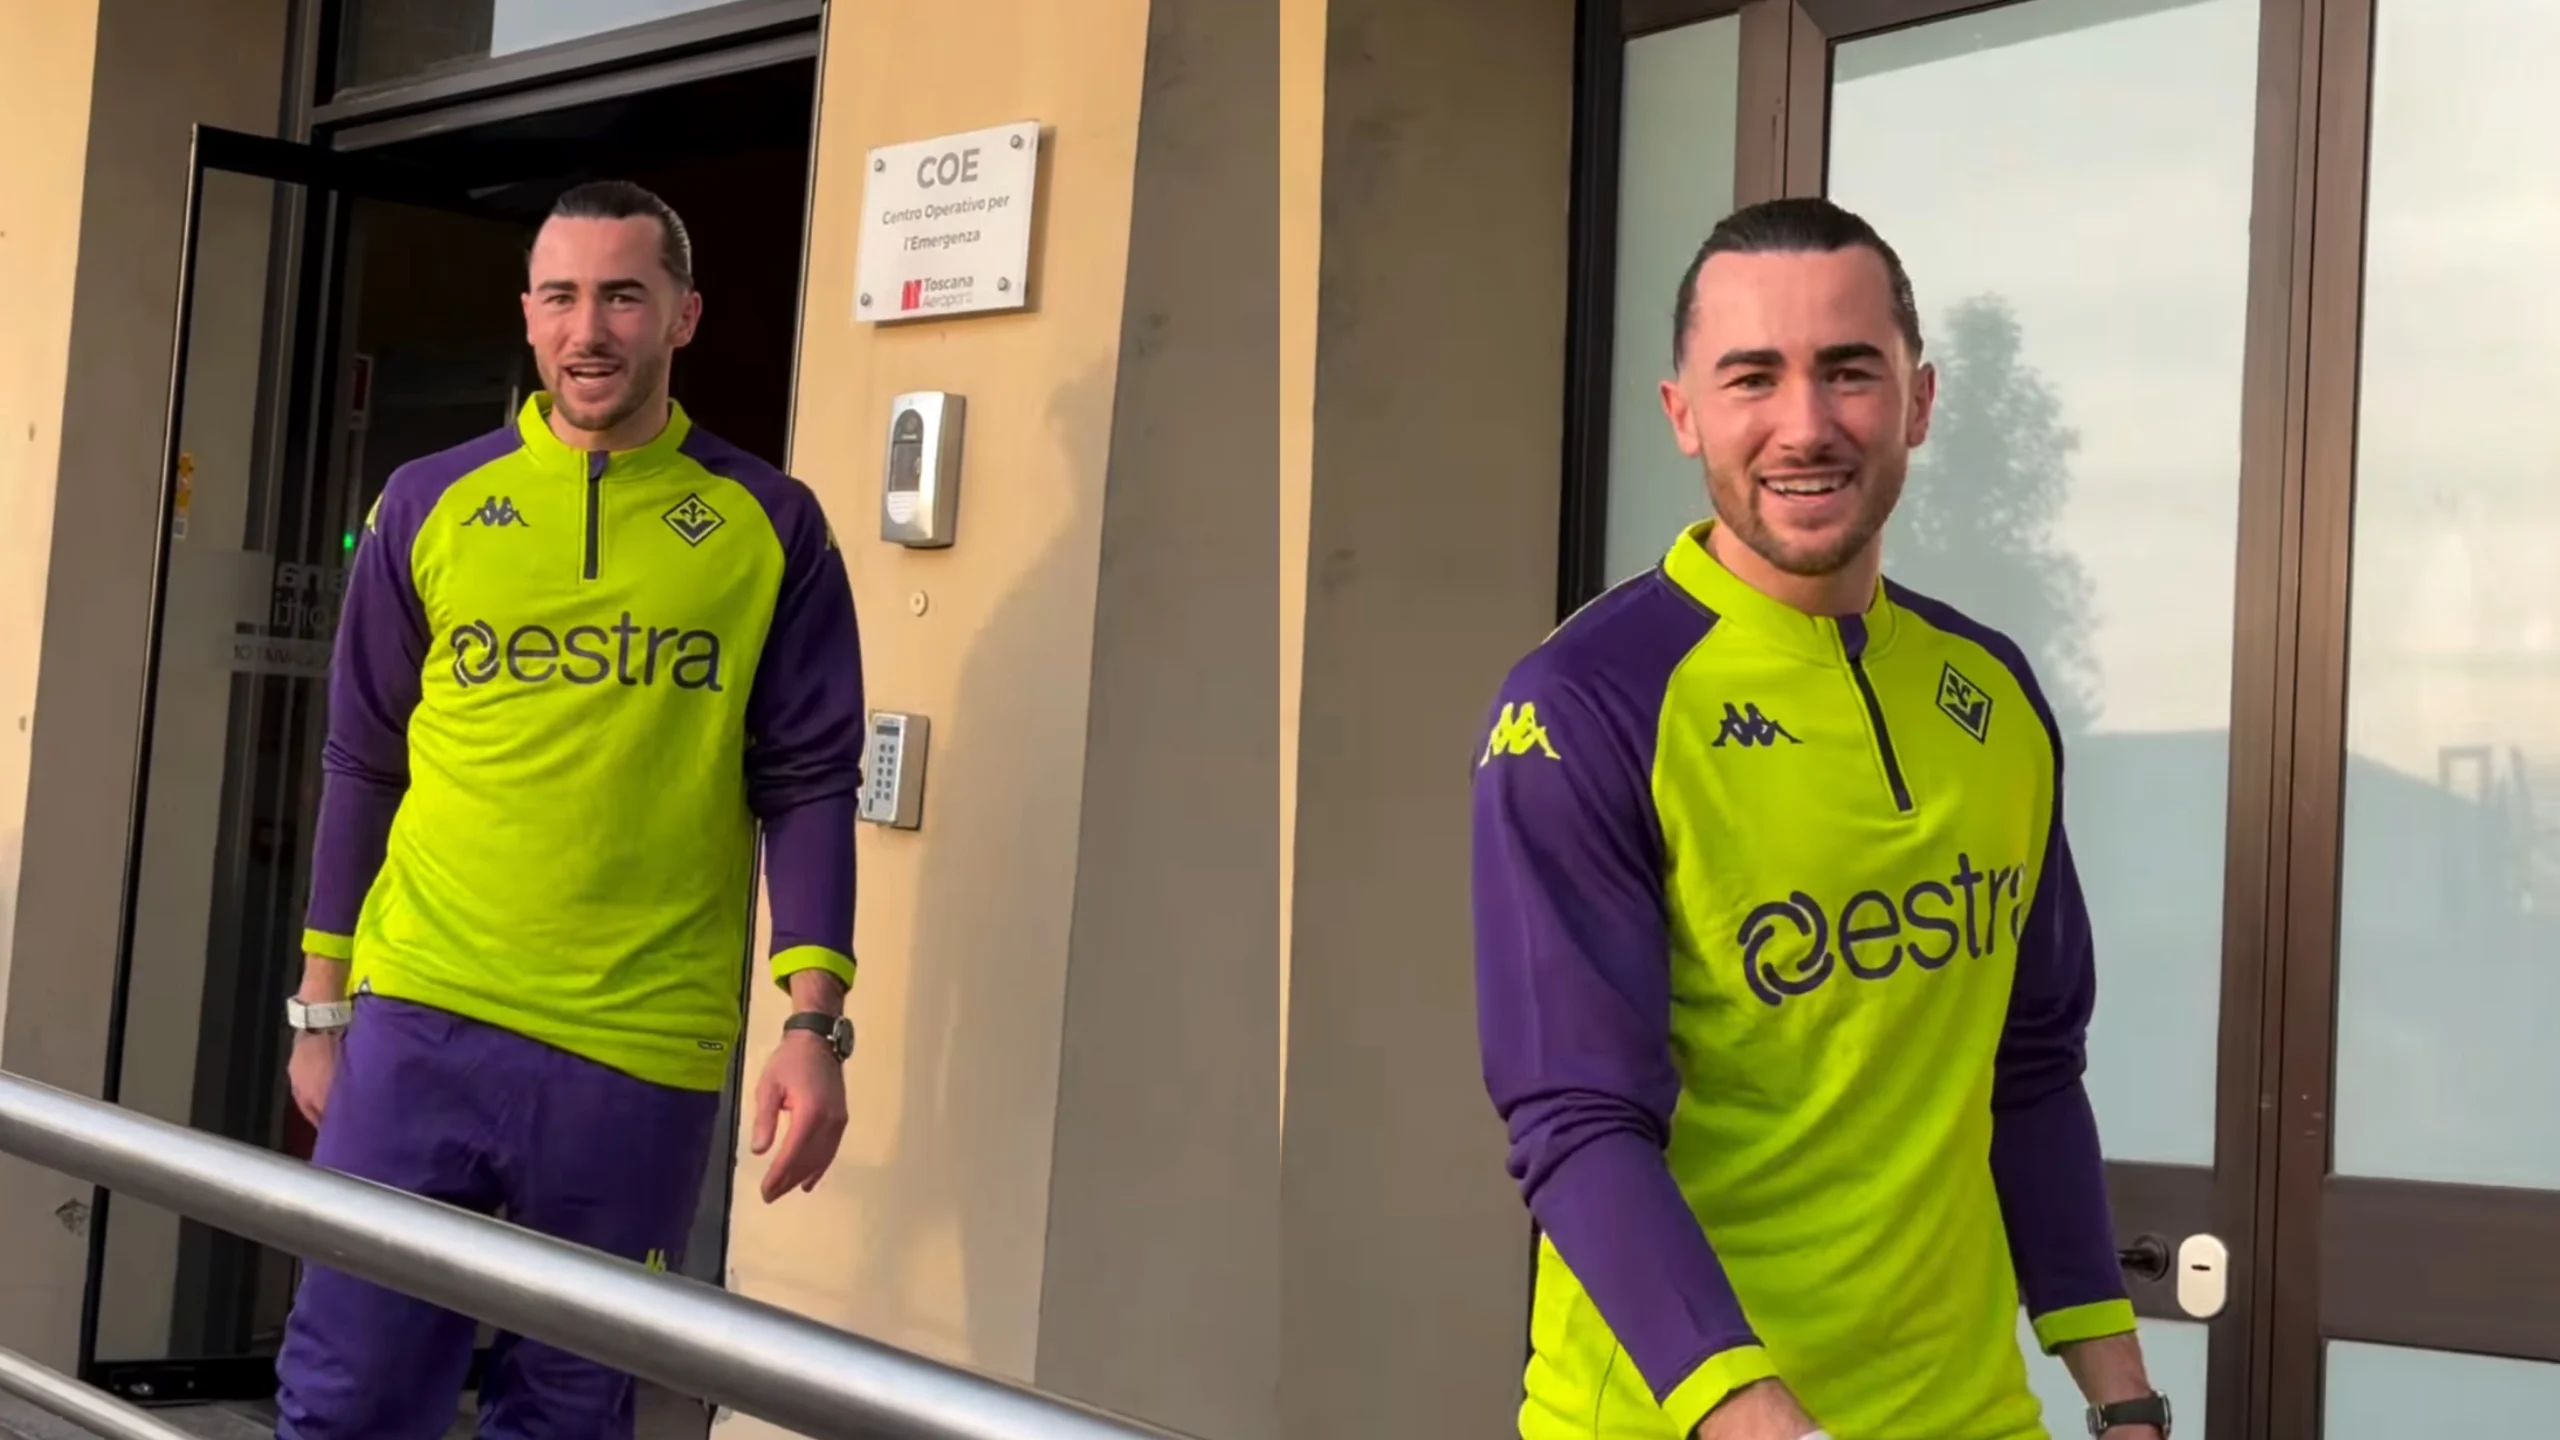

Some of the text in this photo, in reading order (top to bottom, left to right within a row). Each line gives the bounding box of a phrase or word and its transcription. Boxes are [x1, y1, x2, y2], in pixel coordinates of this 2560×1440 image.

[917, 148, 980, 188] COE
[882, 195, 1010, 225] Centro Operativo per
[924, 276, 974, 292] Toscana
[506, 611, 723, 692] estra
